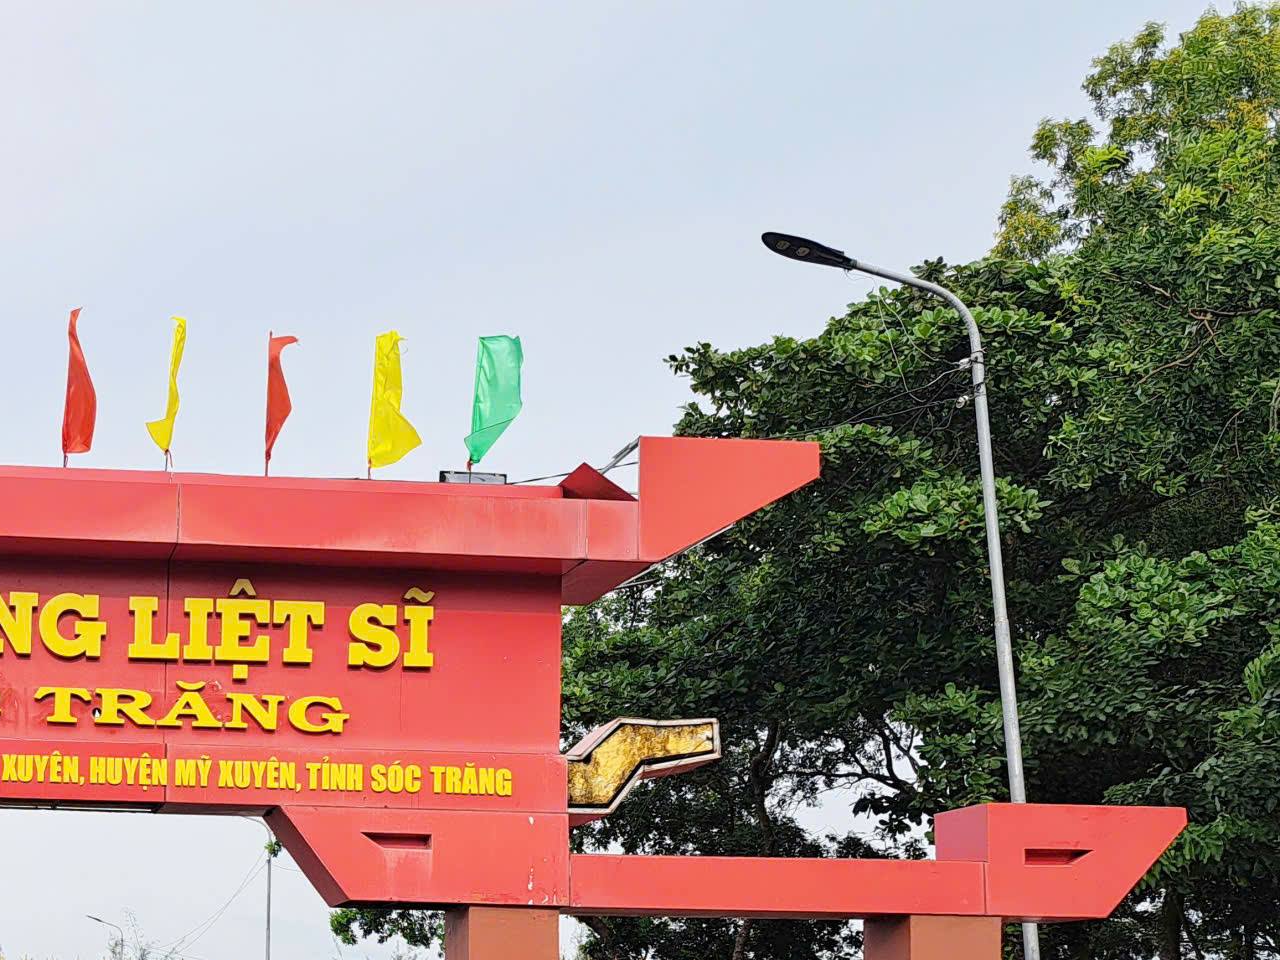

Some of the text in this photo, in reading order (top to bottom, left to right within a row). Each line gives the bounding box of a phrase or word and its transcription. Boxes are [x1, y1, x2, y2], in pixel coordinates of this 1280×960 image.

[128, 578, 325, 680] LIỆT
[348, 587, 435, 668] SĨ
[35, 680, 350, 733] TRĂNG
[2, 751, 86, 786] XUYÊN,
[90, 752, 169, 791] HUYỆN
[175, 755, 212, 788] MỸ
[218, 756, 302, 793] XUYÊN,
[306, 756, 364, 792] TỈNH
[370, 760, 422, 793] SÓC
[430, 762, 513, 797] TRĂNG
